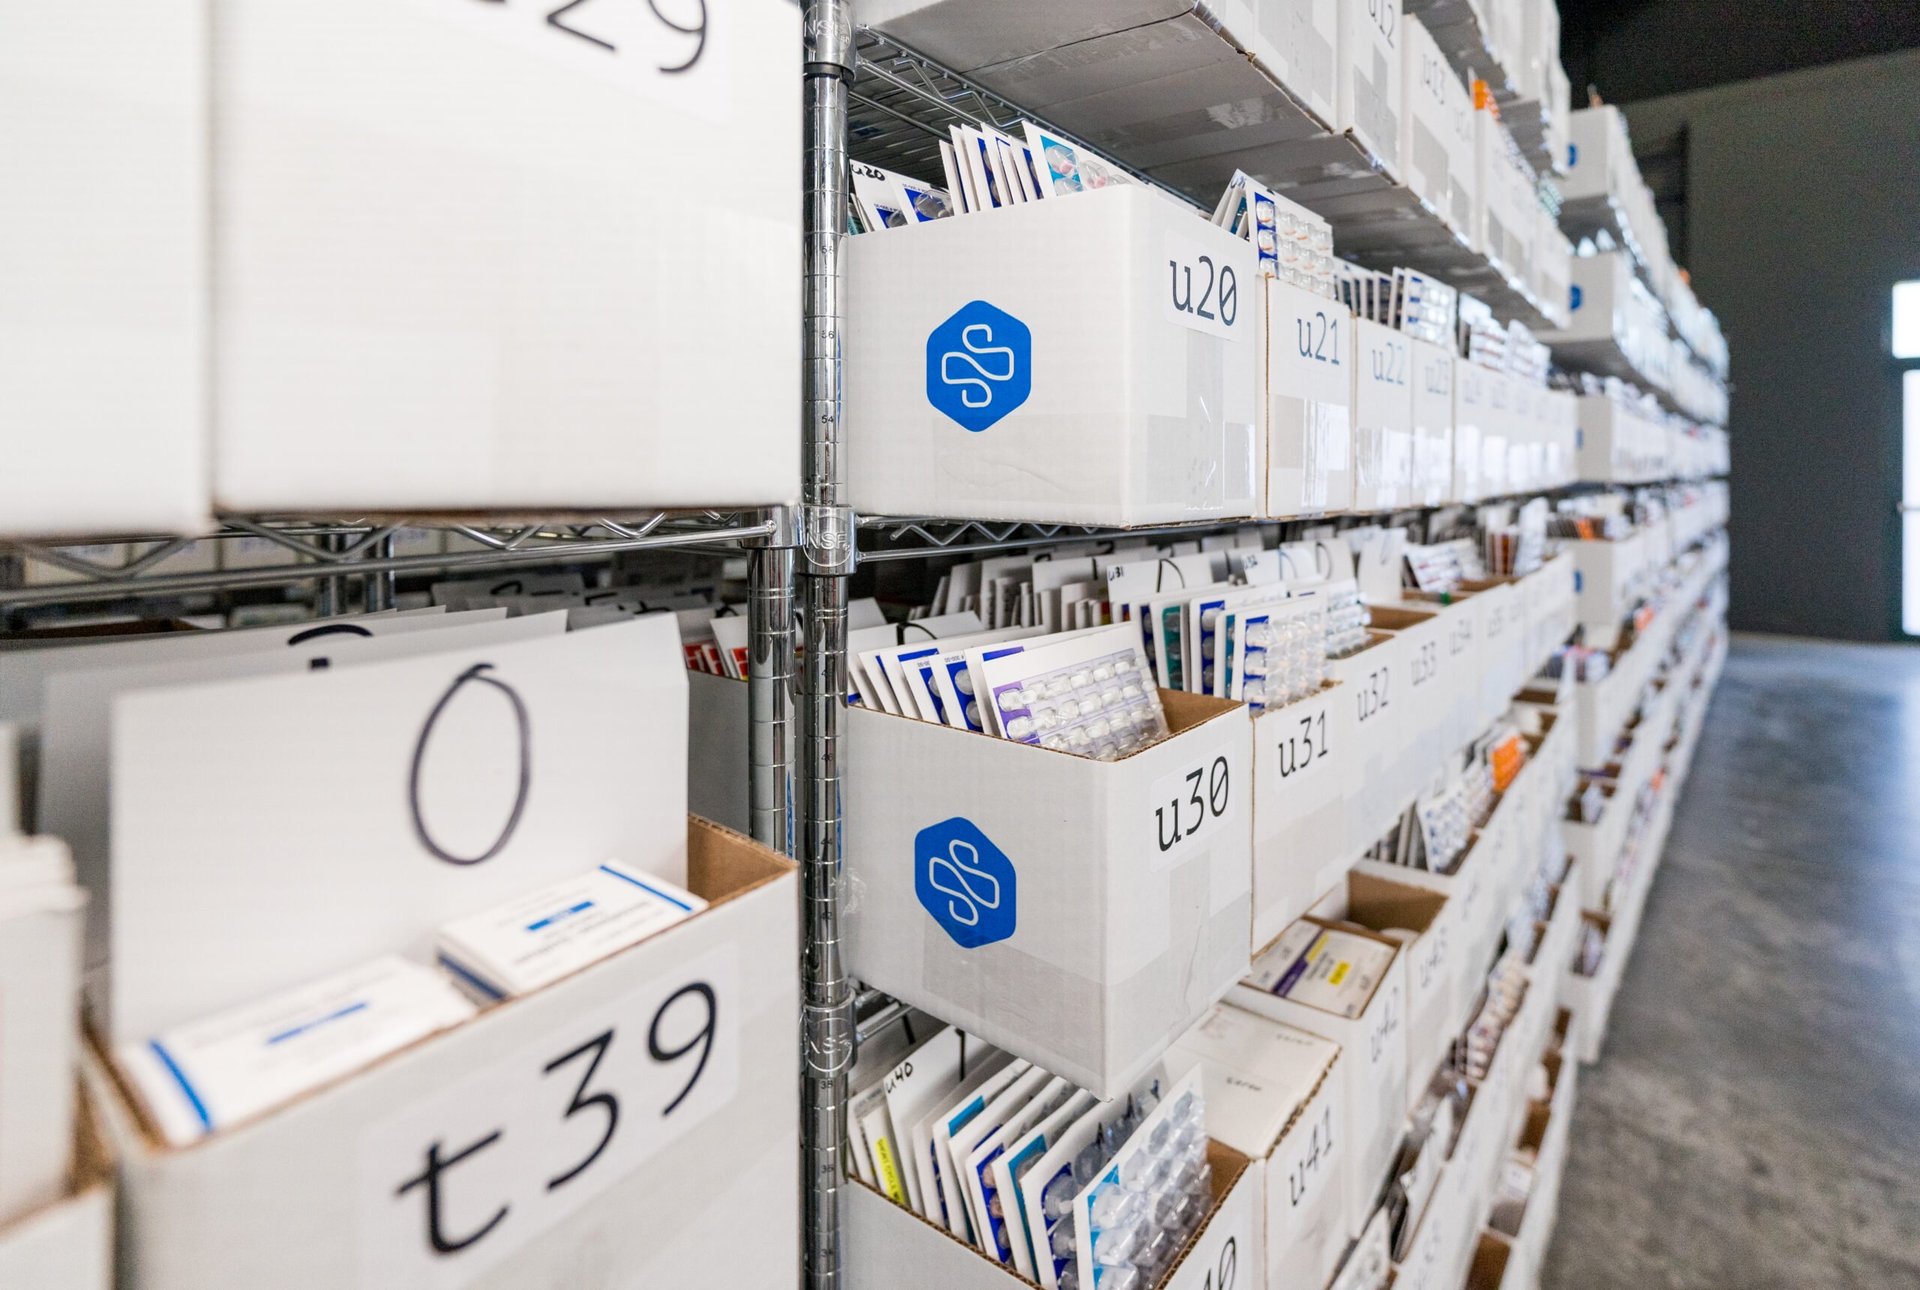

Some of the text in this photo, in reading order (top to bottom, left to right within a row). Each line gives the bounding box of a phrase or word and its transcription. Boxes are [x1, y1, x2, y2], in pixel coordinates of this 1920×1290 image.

[1169, 255, 1237, 327] u20
[1297, 311, 1340, 366] u21
[1372, 341, 1405, 386] u22
[821, 414, 835, 424] 54
[806, 531, 848, 550] NSF
[1357, 666, 1388, 722] u32
[1278, 709, 1329, 778] u31
[1155, 756, 1229, 852] u30
[885, 1061, 914, 1094] u40
[394, 979, 717, 1255] t39
[1290, 1105, 1332, 1208] u41
